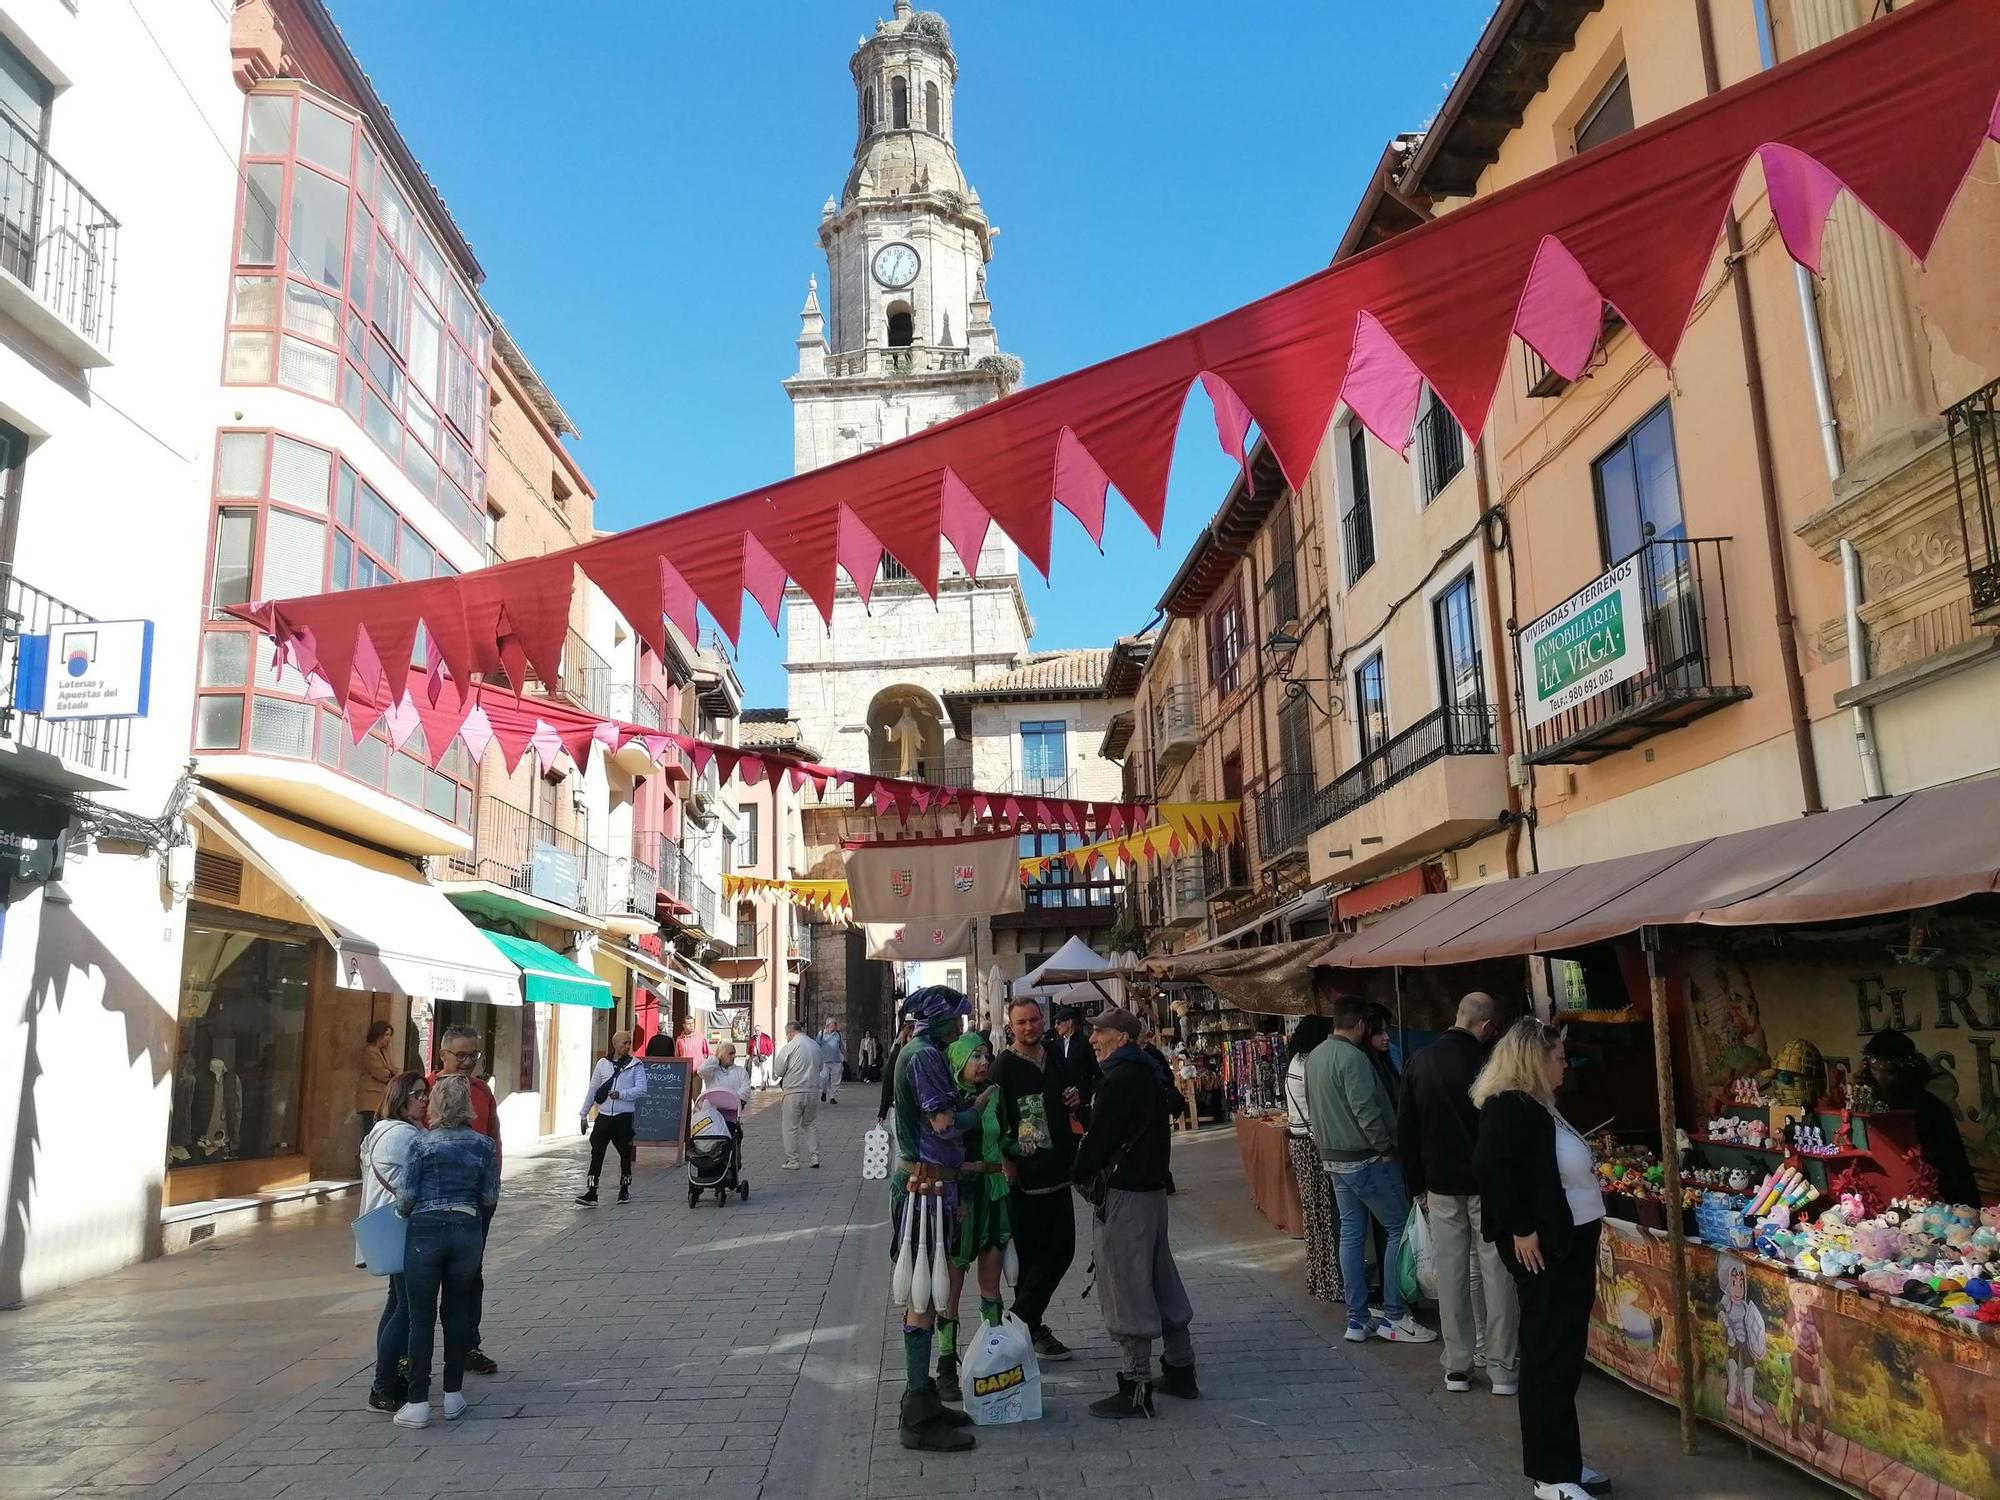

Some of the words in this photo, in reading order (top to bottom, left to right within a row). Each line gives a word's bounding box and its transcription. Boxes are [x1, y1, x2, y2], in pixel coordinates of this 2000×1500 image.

[1525, 604, 1570, 644] VIVIENDAS
[1571, 599, 1579, 612] Y
[1579, 561, 1632, 607] TERRENOS
[1537, 599, 1618, 663] INMOBILIARIA
[1542, 657, 1562, 692] LA
[1566, 626, 1618, 676] VEGA
[58, 689, 101, 701] Apuestas
[103, 688, 118, 697] del
[98, 680, 104, 689] y
[1568, 686, 1583, 703] 980
[1584, 676, 1599, 694] 691
[1599, 667, 1614, 687] 082
[56, 700, 89, 710] Estado
[0, 829, 38, 851] Estado
[1848, 973, 1922, 1036] EL
[650, 1063, 671, 1071] CASA
